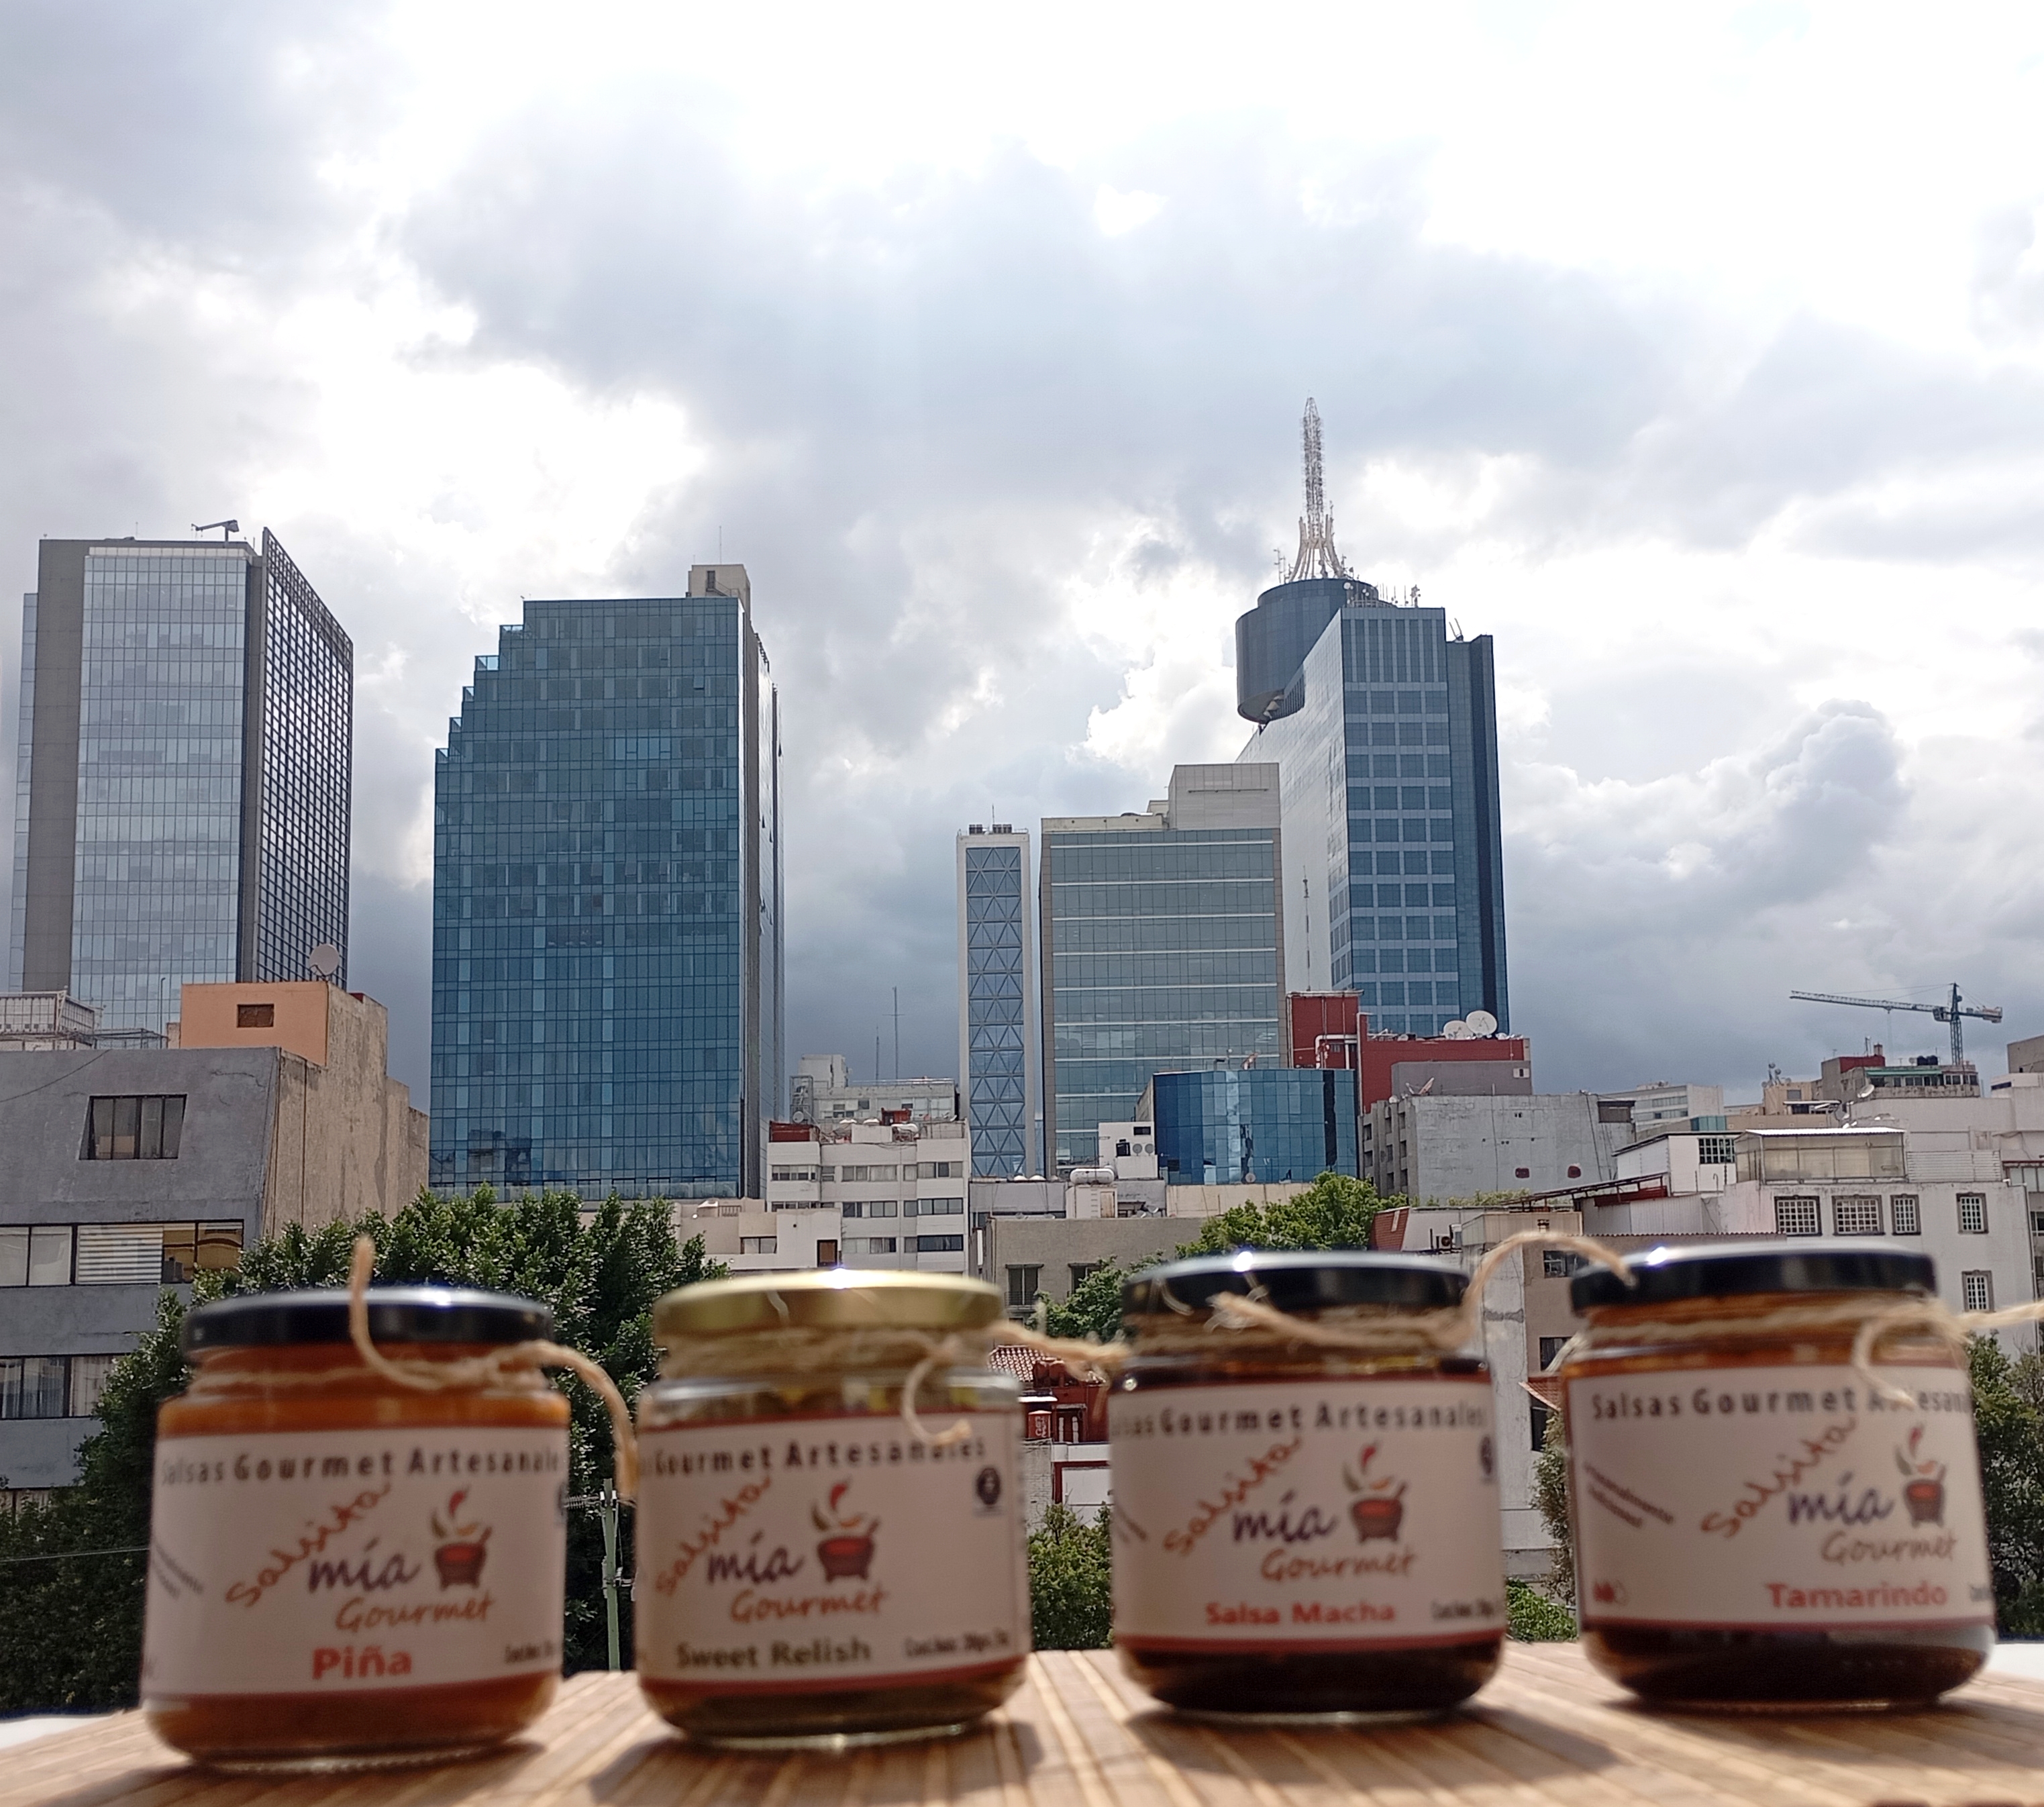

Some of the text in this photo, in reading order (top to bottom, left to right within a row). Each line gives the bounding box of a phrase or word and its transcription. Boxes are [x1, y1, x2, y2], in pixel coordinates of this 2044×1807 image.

[1160, 1404, 1302, 1435] Gourmet
[1592, 1392, 1681, 1420] Salsas
[1692, 1386, 1855, 1415] Gourmet
[234, 1449, 391, 1481] Gourmet
[654, 1447, 771, 1476] Gourmet
[1700, 1416, 1857, 1539] Salsita
[1233, 1488, 1339, 1544] mía
[1787, 1470, 1895, 1527] mía
[224, 1481, 392, 1608] Salsita
[707, 1529, 805, 1586] mía
[1821, 1529, 1957, 1566] Gourmet
[307, 1537, 421, 1595] mía
[1260, 1546, 1415, 1582] Gourmet
[334, 1590, 497, 1633] Gourmet
[730, 1584, 887, 1625] Gourmet
[1765, 1580, 1947, 1608] Tamarindo
[1205, 1600, 1396, 1626] Salsa Macha
[311, 1645, 413, 1680] Piña
[676, 1641, 759, 1669] Sweet
[771, 1635, 872, 1666] Relish
